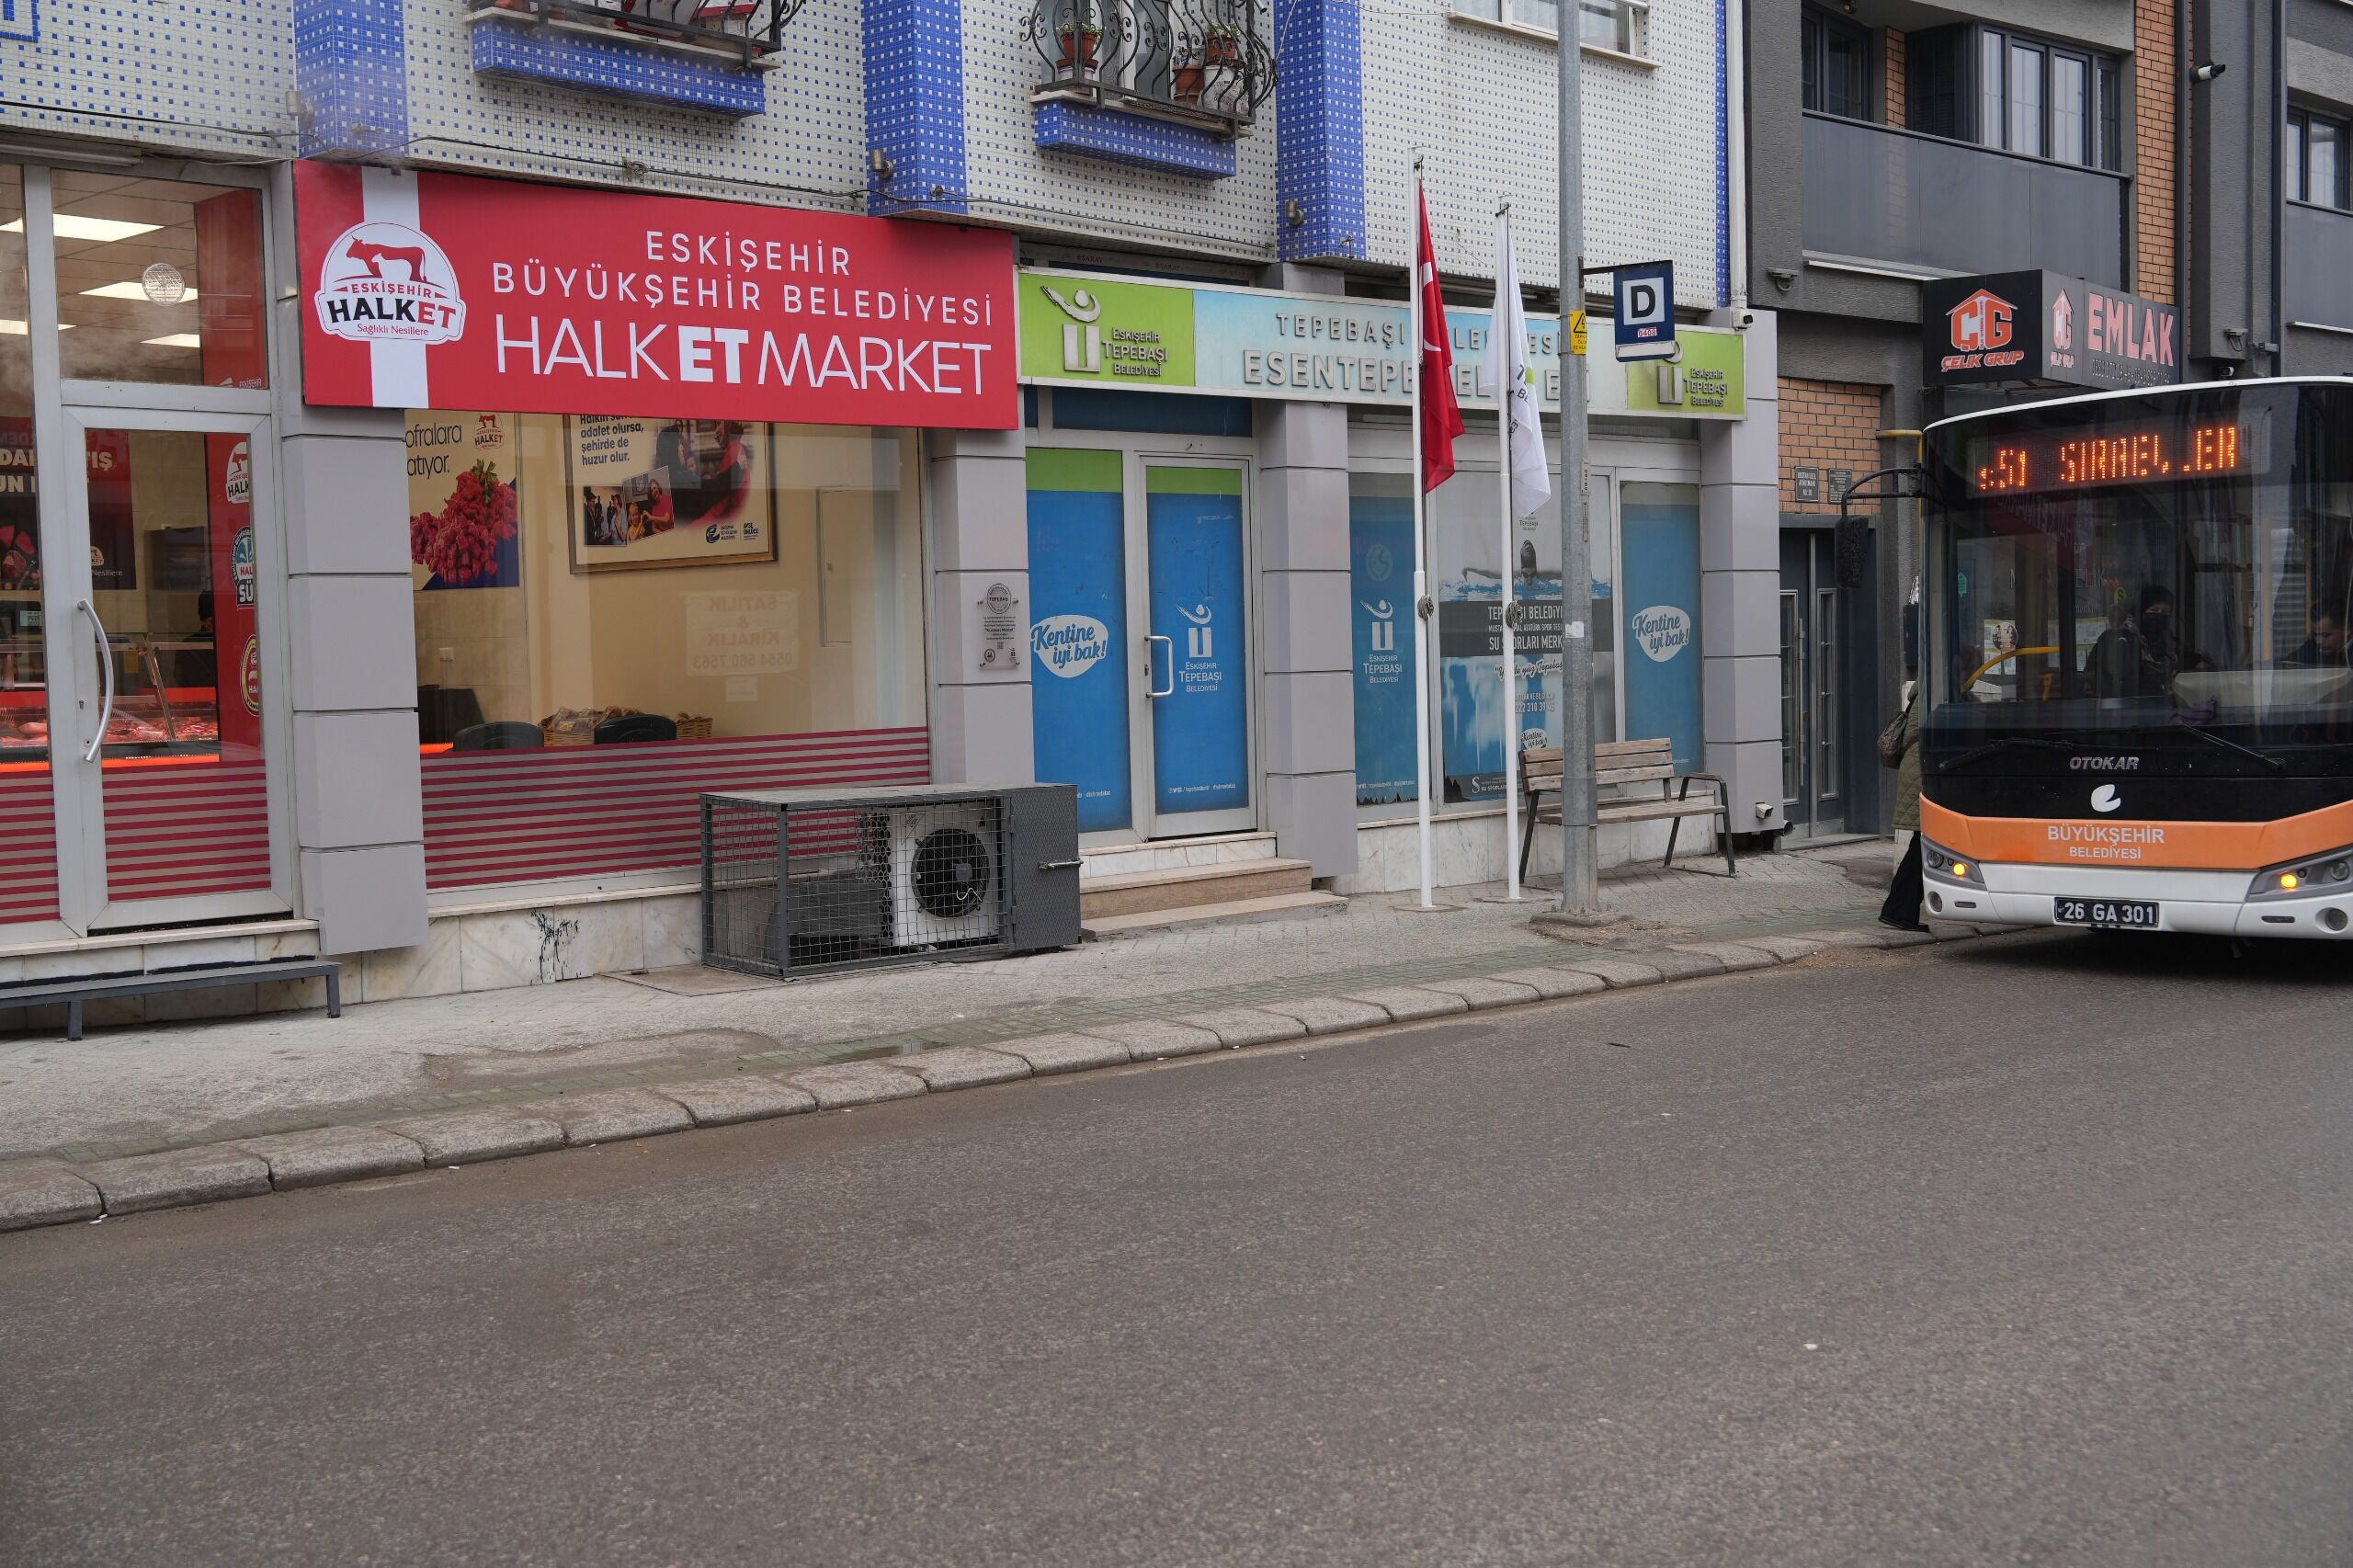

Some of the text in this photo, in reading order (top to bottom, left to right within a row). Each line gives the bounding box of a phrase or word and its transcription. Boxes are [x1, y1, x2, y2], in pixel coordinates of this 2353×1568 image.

[647, 230, 851, 277] ESKİŞEHİR
[351, 280, 432, 299] ESKİŞEHİR
[494, 262, 993, 326] BÜYÜKŞEHİR BELEDİYESİ
[1631, 284, 1655, 319] D
[326, 297, 457, 329] HALKET
[358, 324, 429, 335] Sağlıklı Nesillere
[1276, 312, 1404, 348] TEPEBAŞI
[2088, 292, 2174, 367] EMLAK
[1102, 340, 1168, 365] TEPEBAŞI
[1984, 351, 2025, 367] GRUP
[1114, 363, 1162, 377] BELEDİYESİ
[1243, 349, 1413, 392] ESENTEPE
[1684, 379, 1728, 398] TEPEBAŞI
[405, 423, 462, 448] ofralara
[474, 434, 503, 446] HALKET
[581, 423, 644, 438] adalet olursa,
[581, 437, 629, 453] şehirde de
[407, 454, 450, 479] atıyor.
[582, 451, 630, 466] huzur olur.
[239, 580, 254, 602] SÜ
[1634, 613, 1681, 637] Kentine
[1030, 623, 1096, 651] Kentine
[1489, 637, 1499, 651] SU
[1650, 628, 1689, 653] iyi bak!
[1053, 640, 1106, 669] iyi bak!
[1178, 671, 1222, 683] TEPEBAŞI
[1363, 663, 1403, 675] TEPEBAŞI
[1186, 684, 1218, 692] BELEDİYESİ
[1527, 703, 1538, 712] 310
[2069, 756, 2140, 770] OTOKAR
[2047, 824, 2165, 846] BÜYÜKŞEHİR
[2068, 846, 2142, 860] BELEDİYESİ
[2064, 902, 2154, 924] 26 GA 301
